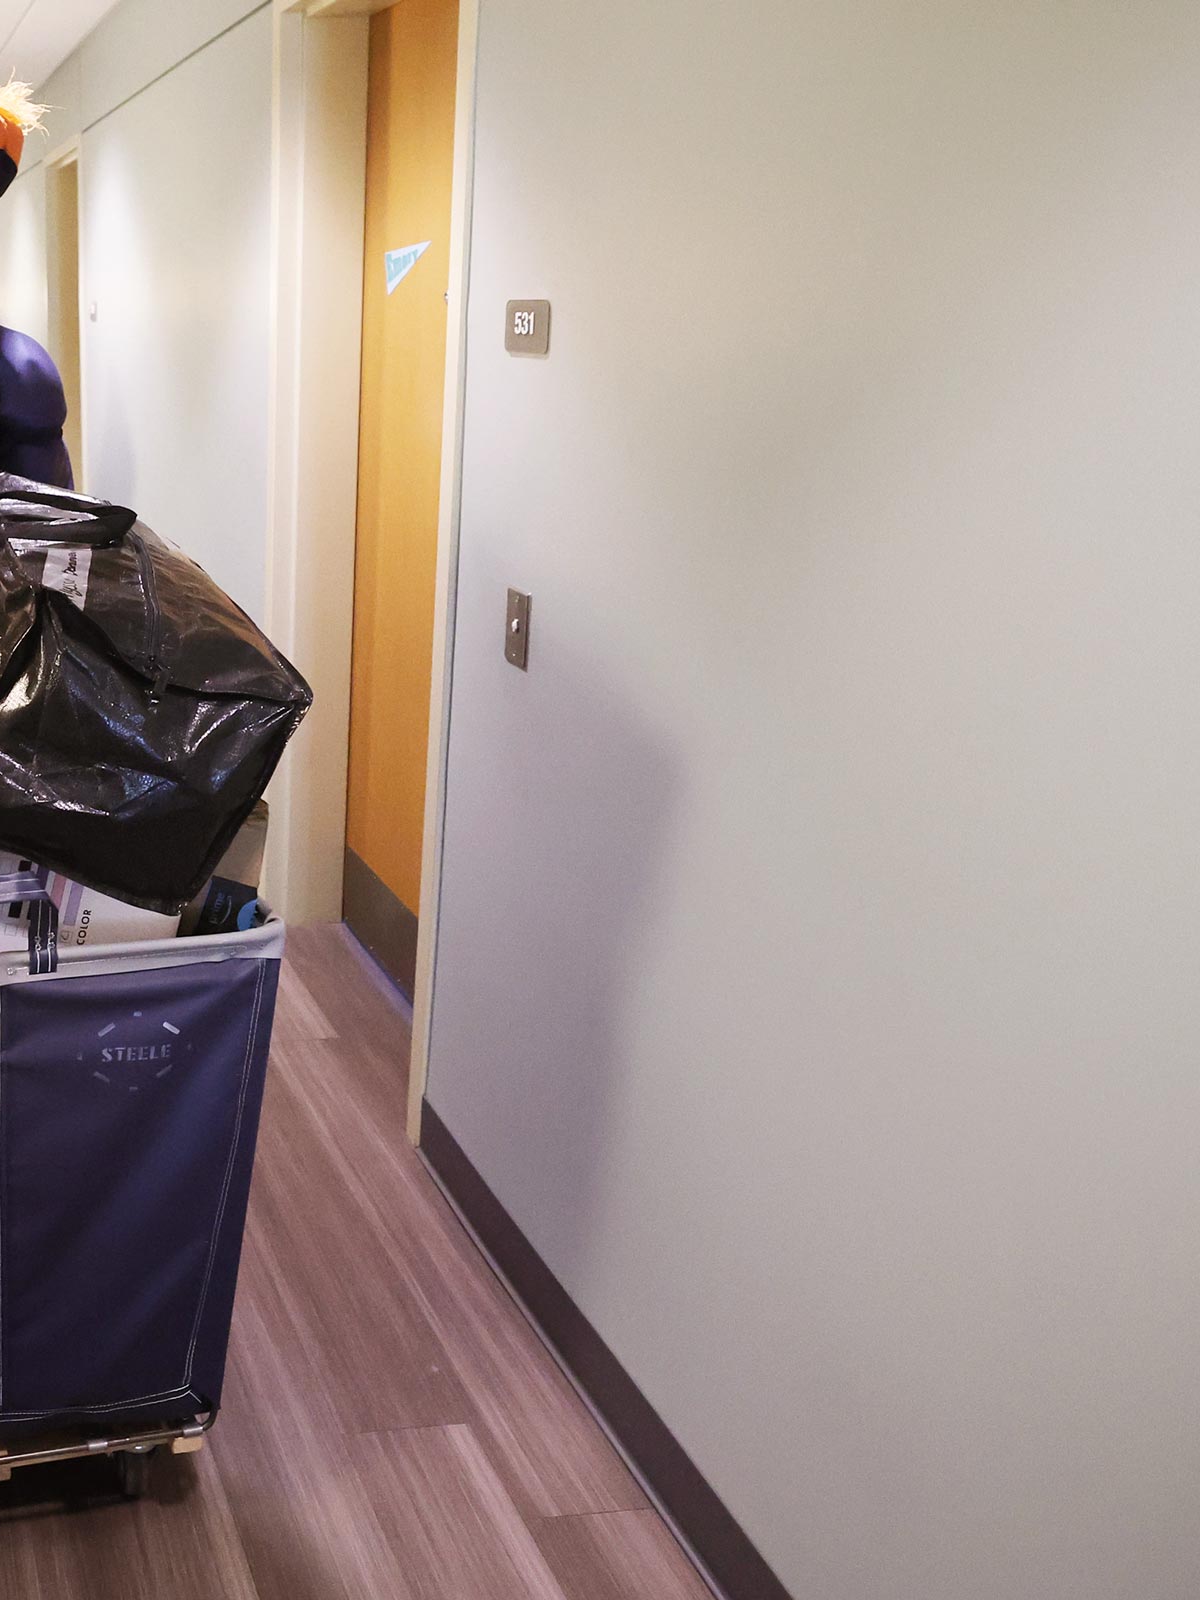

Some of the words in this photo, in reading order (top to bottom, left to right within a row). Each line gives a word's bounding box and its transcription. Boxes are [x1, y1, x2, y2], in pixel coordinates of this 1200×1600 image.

[514, 312, 535, 335] 531
[75, 908, 92, 946] COLOR
[102, 1044, 171, 1062] STEELE
